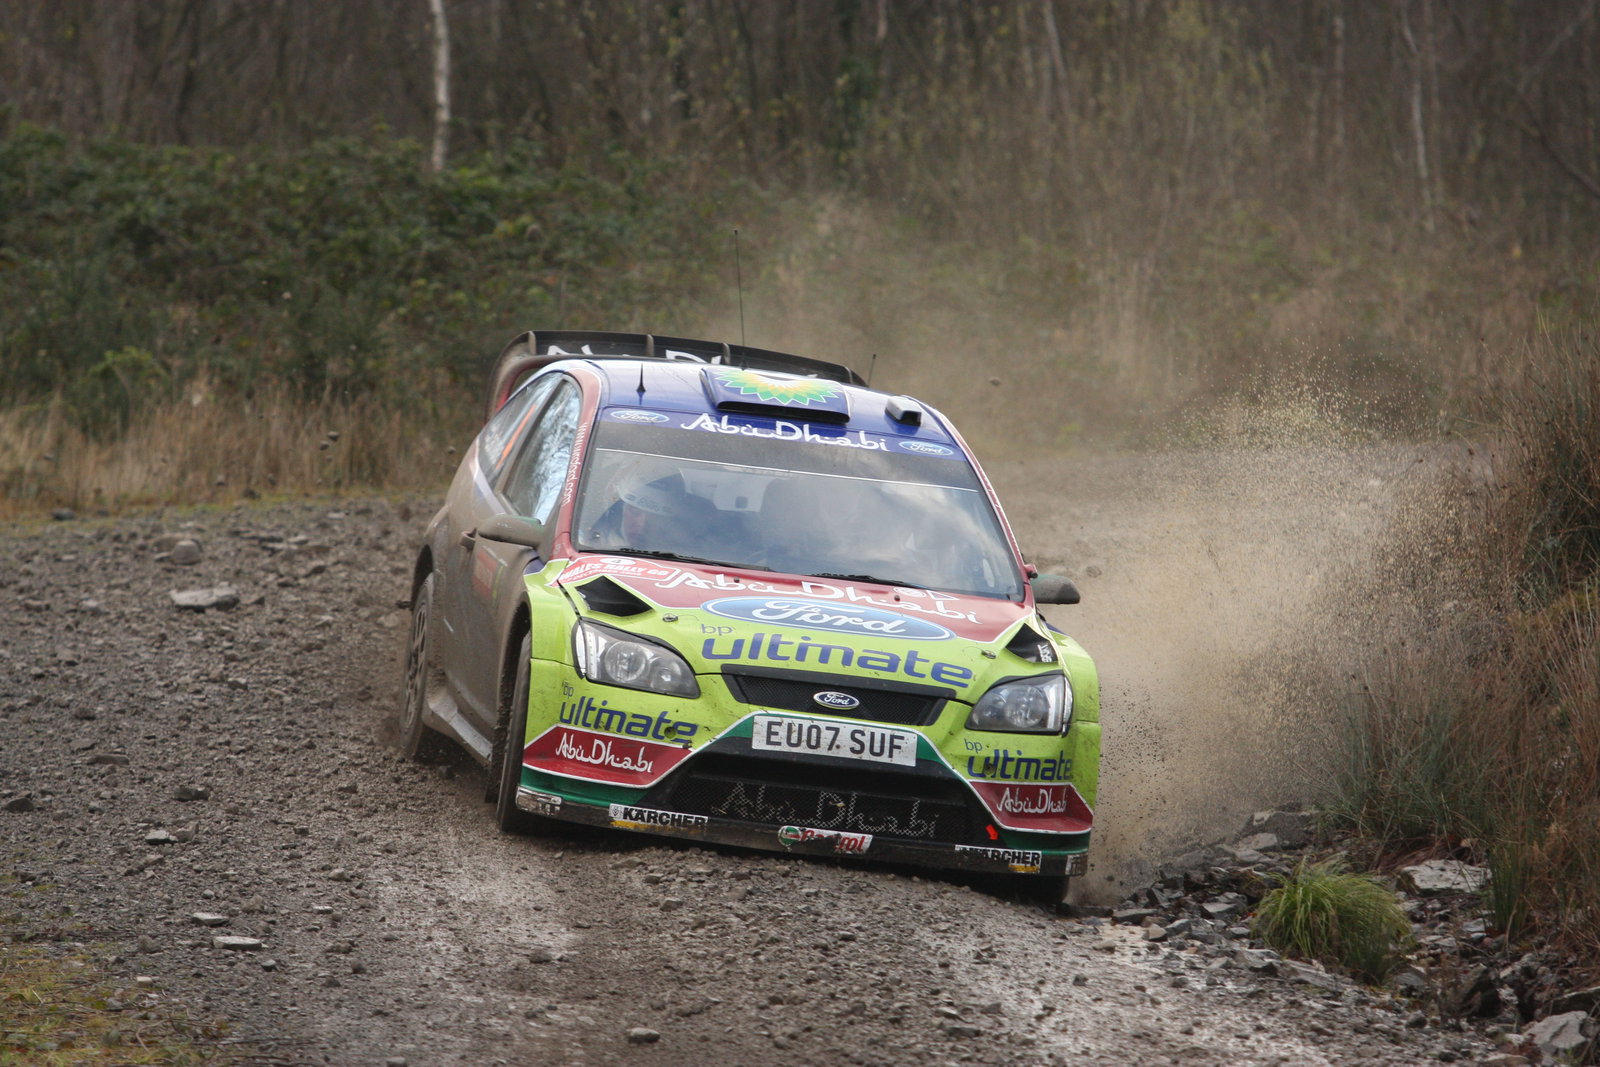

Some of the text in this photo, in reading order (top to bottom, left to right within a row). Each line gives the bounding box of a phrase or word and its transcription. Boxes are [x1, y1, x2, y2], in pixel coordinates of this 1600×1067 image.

[620, 411, 659, 423] Ford
[907, 441, 945, 454] Ford
[560, 563, 604, 580] WALES
[604, 564, 647, 573] RALLY
[751, 599, 908, 635] Ford
[701, 623, 734, 637] bp
[701, 633, 973, 688] ultimate
[824, 693, 850, 705] Ford
[559, 696, 699, 744] ultimate
[766, 721, 905, 759] EU07 SUF
[964, 738, 983, 754] bp
[967, 749, 1073, 781] ultimate
